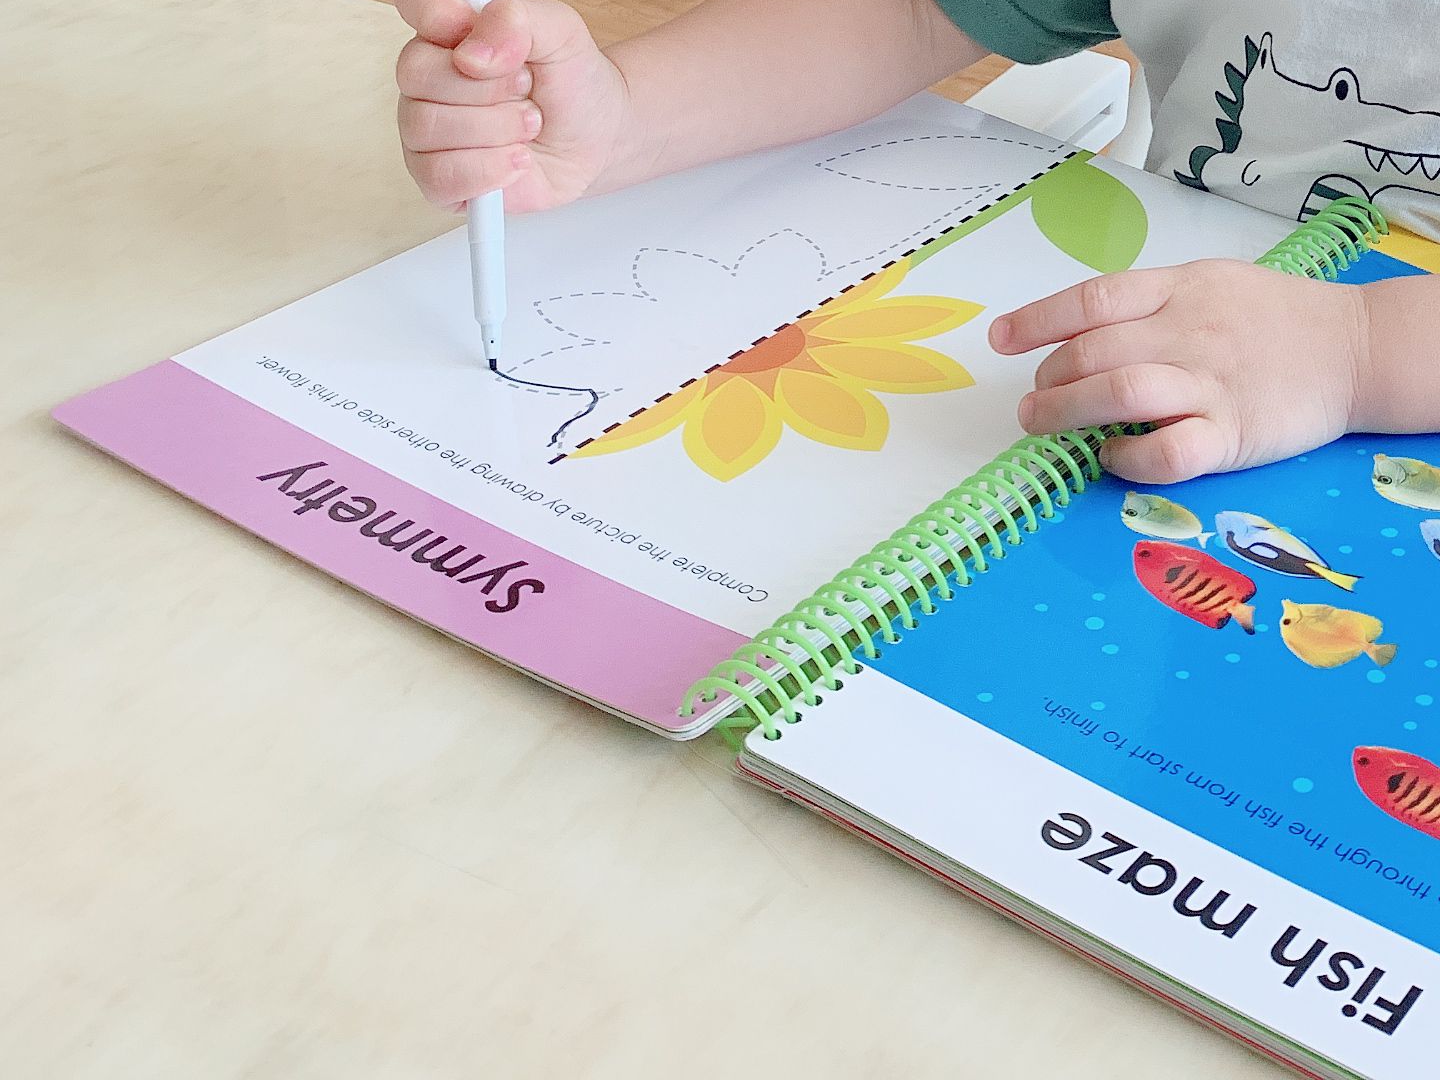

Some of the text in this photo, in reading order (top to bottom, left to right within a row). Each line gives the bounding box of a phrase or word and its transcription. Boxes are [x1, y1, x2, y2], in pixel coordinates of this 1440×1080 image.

[256, 356, 769, 603] Complete the picture by drawing the other side of this flower.
[256, 461, 545, 613] Symmetry
[1043, 696, 1100, 736] finish.
[1103, 730, 1128, 750] to
[1128, 744, 1183, 776] start
[1185, 771, 1241, 807] from
[1244, 799, 1284, 829] fish
[1288, 820, 1329, 851] the
[1334, 843, 1432, 900] through
[1041, 811, 1424, 1036] Fish maze
